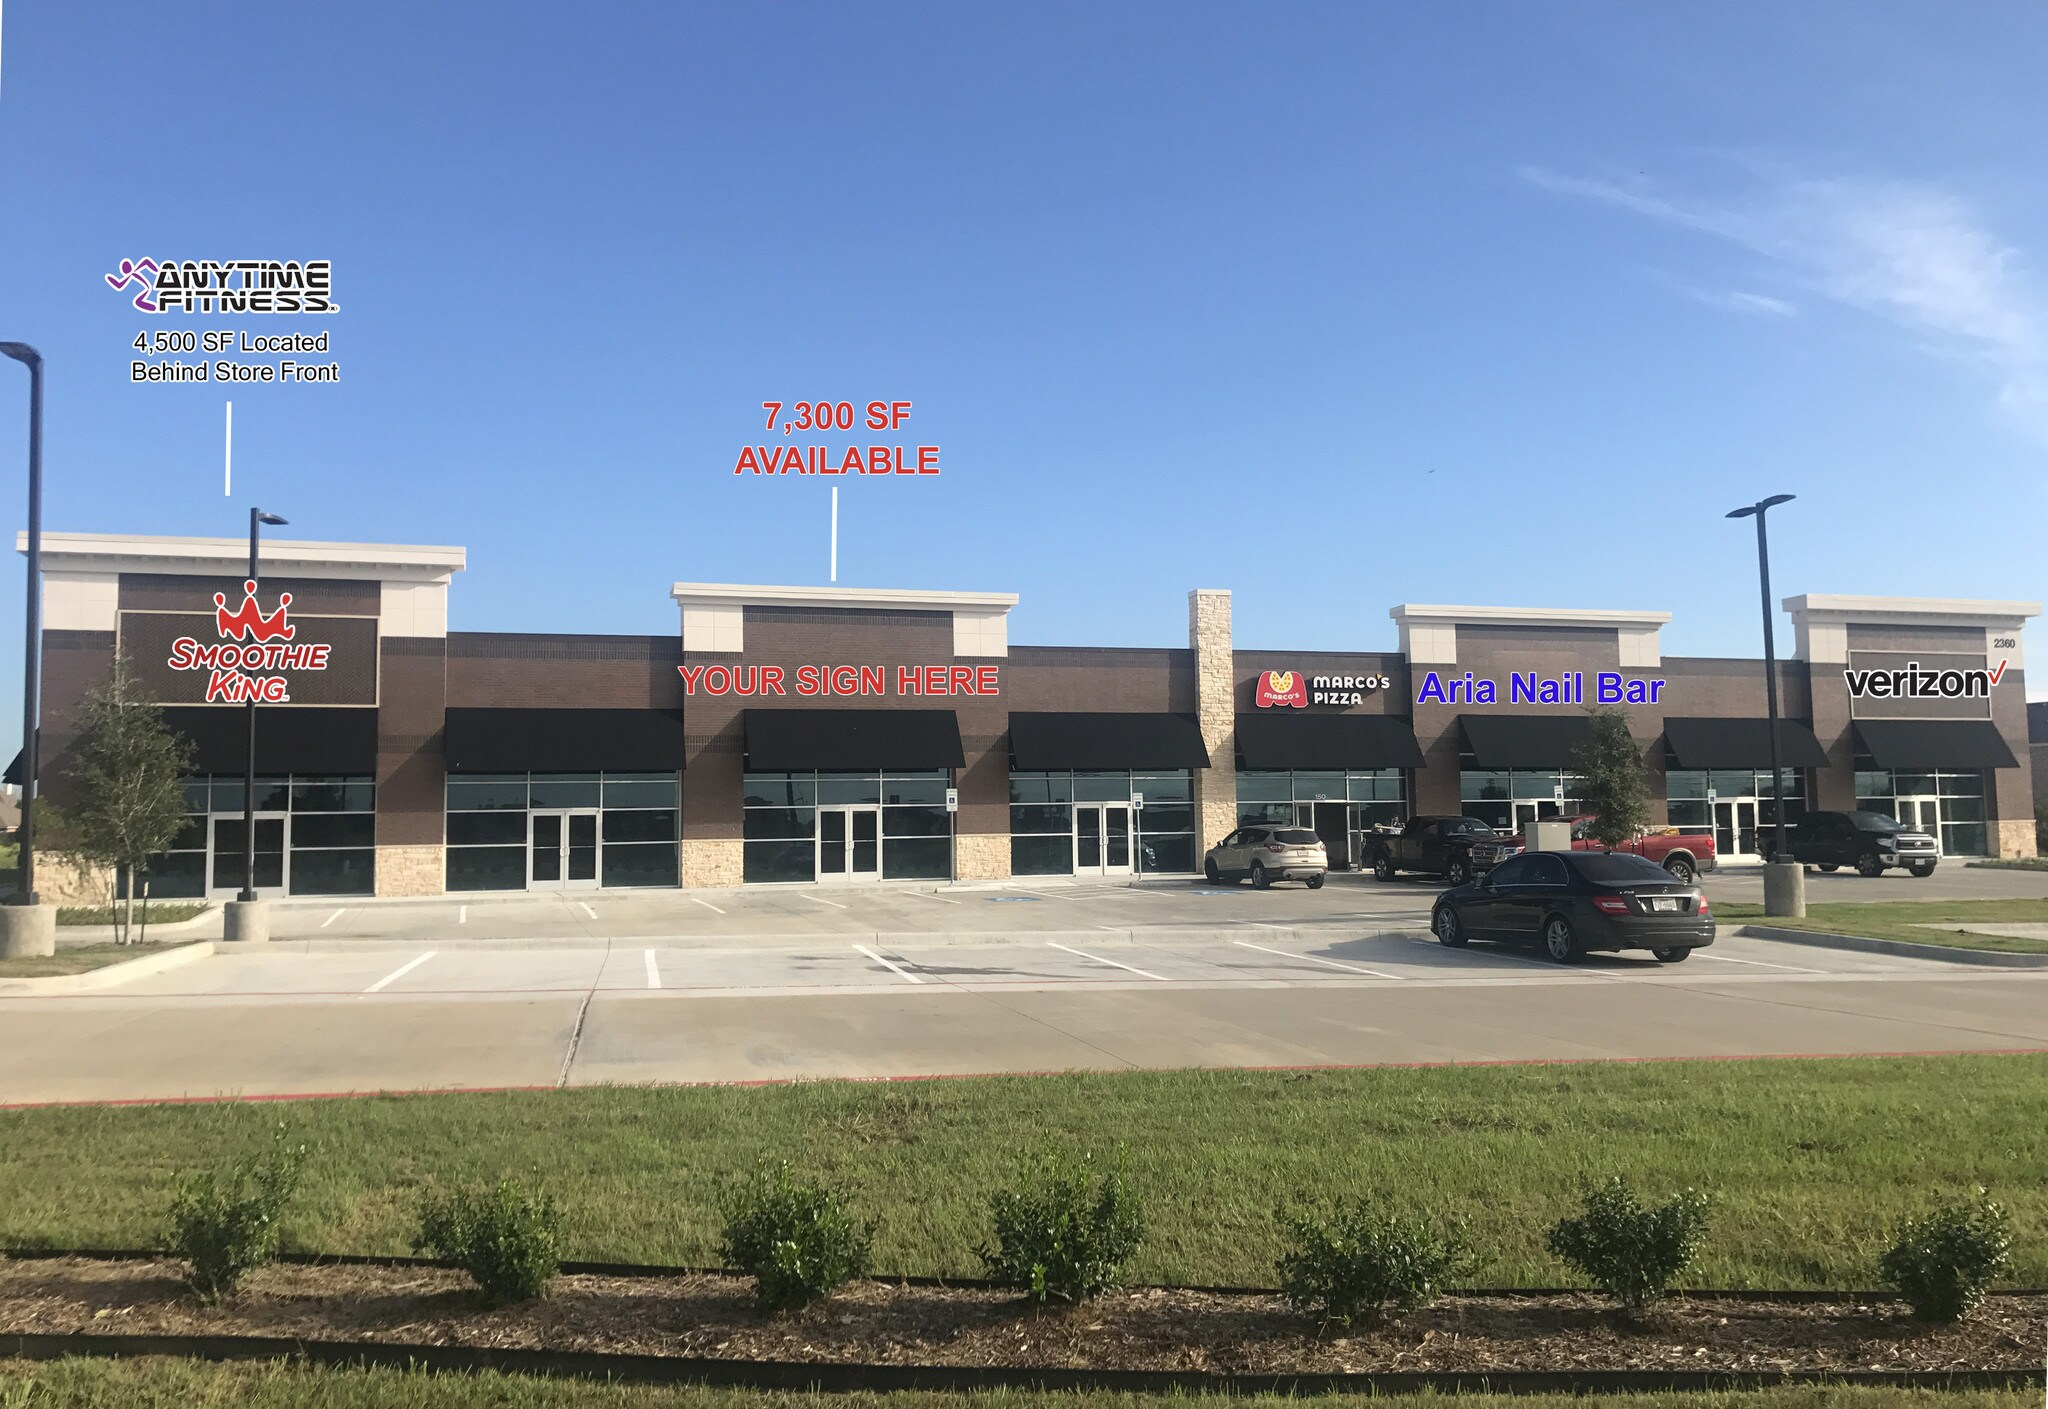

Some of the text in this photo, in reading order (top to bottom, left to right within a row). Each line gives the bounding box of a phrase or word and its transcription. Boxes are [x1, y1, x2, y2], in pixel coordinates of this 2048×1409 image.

[1993, 638, 2016, 649] 2360
[1313, 673, 1390, 688] MARCO'S
[1263, 691, 1300, 701] MARCO'S
[1313, 692, 1361, 704] PIZZA
